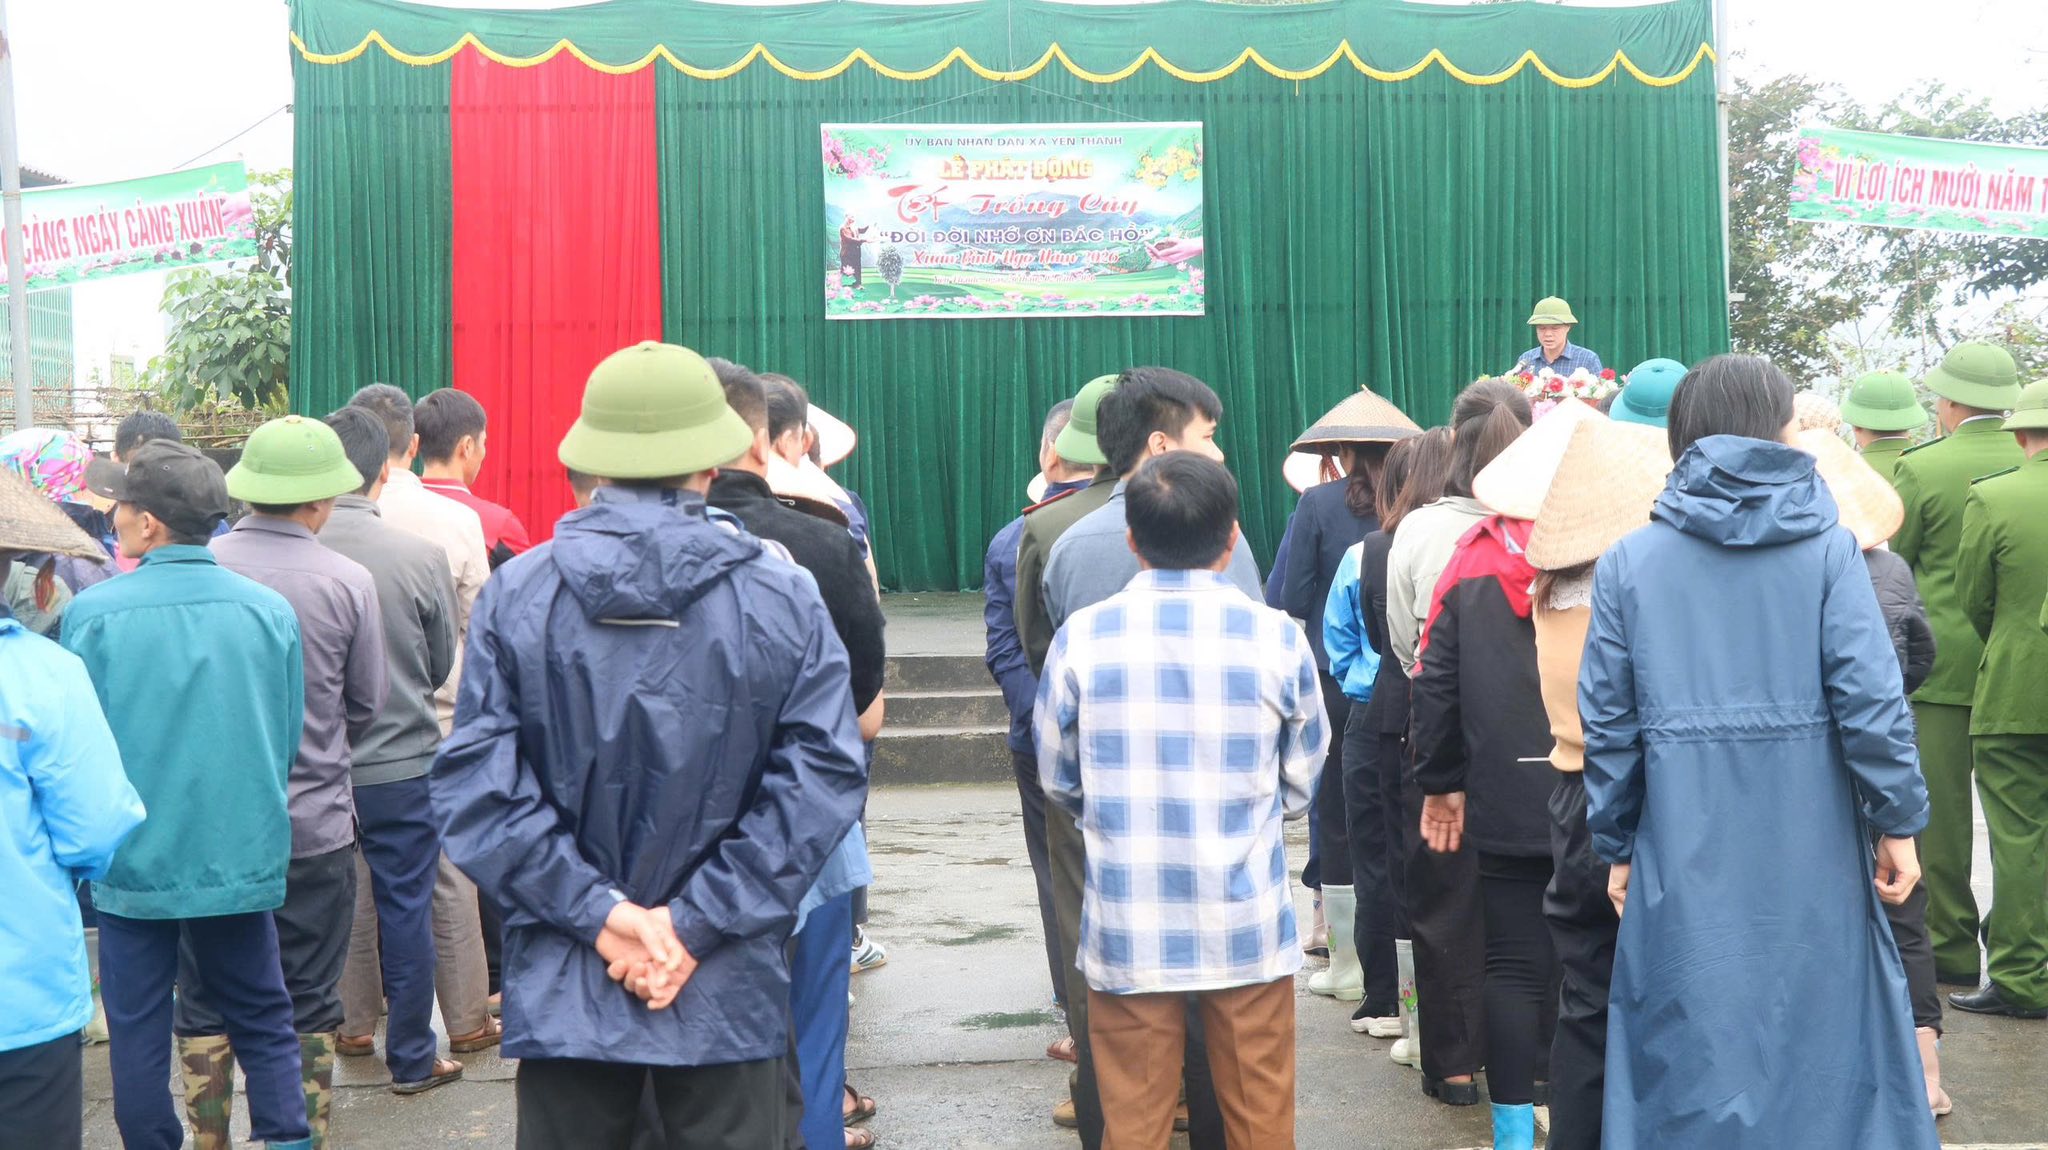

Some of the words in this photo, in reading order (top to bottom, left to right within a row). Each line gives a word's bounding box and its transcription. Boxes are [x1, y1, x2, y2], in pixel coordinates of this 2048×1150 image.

[926, 137, 953, 147] BAN
[887, 184, 950, 223] Tết
[1834, 156, 1852, 199] VÌ
[1856, 161, 1888, 209] LỢI
[1891, 159, 1926, 204] ÍCH
[1929, 162, 1981, 209] MƯỜI
[1986, 167, 2036, 213] NĂM
[124, 200, 174, 249] CÀNG
[176, 191, 225, 241] XUÂN
[933, 227, 968, 243] ĐỜI
[975, 225, 1020, 243] NHỚ
[1024, 227, 1057, 243] ƠN
[1061, 225, 1103, 242] BÁC
